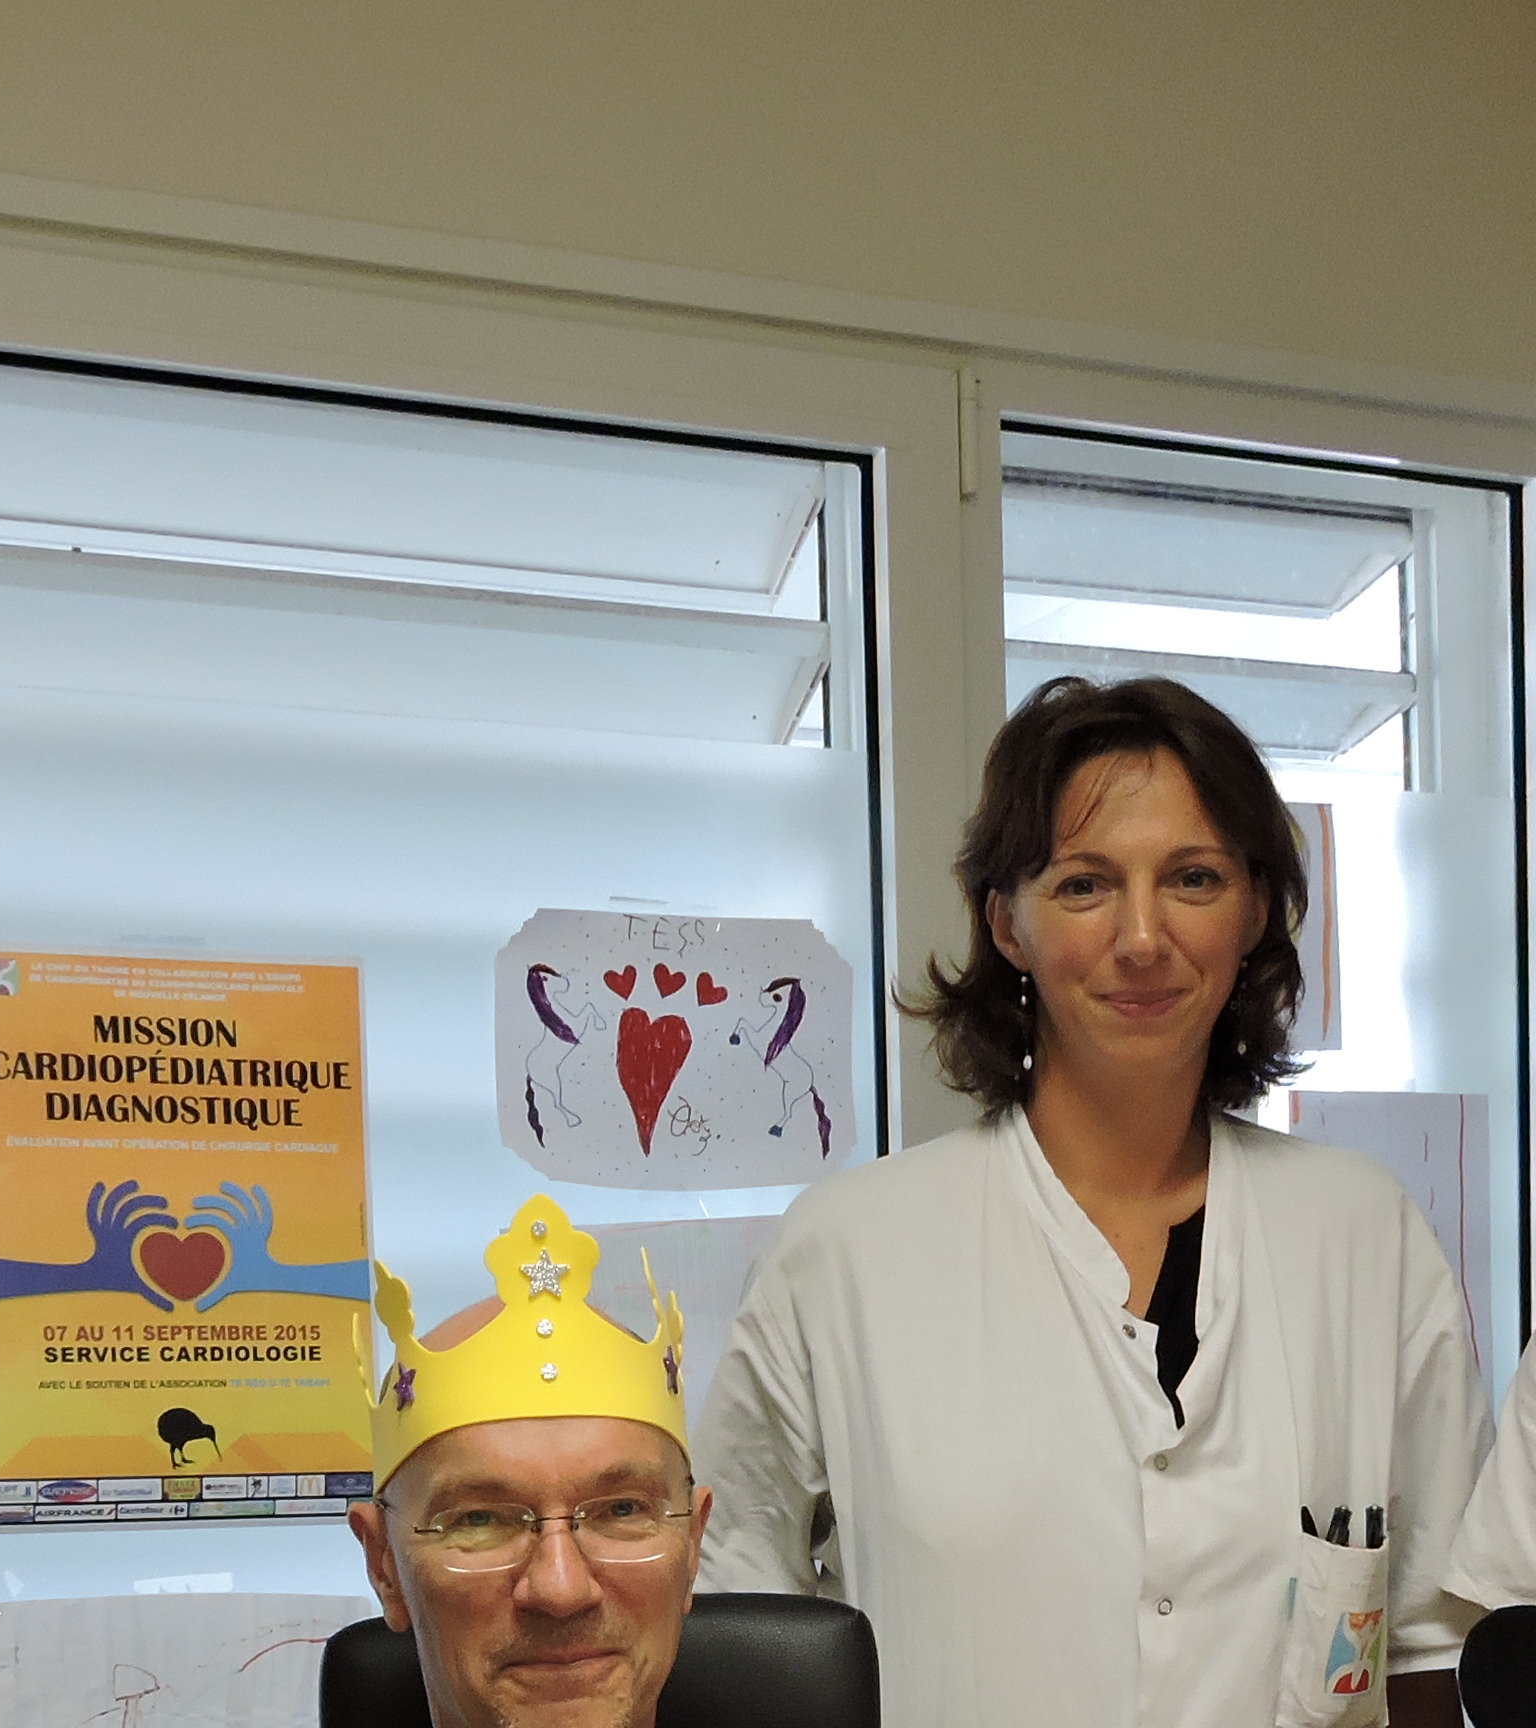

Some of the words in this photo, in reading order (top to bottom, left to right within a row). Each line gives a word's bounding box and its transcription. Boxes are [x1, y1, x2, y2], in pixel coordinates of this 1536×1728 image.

[623, 913, 704, 958] TESS
[92, 1015, 237, 1048] MISSION
[45, 1092, 303, 1131] DIAGNOSTIQUE
[83, 1137, 120, 1150] AVANT
[192, 1140, 207, 1151] DE
[211, 1140, 272, 1152] CHIRURGIE
[274, 1142, 339, 1154] CARDIAQUE
[43, 1325, 68, 1341] 07
[75, 1325, 104, 1341] AU
[112, 1325, 134, 1341] 11
[143, 1325, 267, 1341] SEPTEMBRE
[273, 1324, 321, 1341] 2015
[43, 1346, 150, 1363] SERVICE
[159, 1345, 323, 1363] CARDIOLOGIE
[38, 1380, 66, 1390] AVEC
[69, 1380, 82, 1389] LE
[86, 1380, 131, 1389] SOUTIEN
[134, 1380, 147, 1389] DE
[150, 1379, 226, 1389] L'ASSOCIATION
